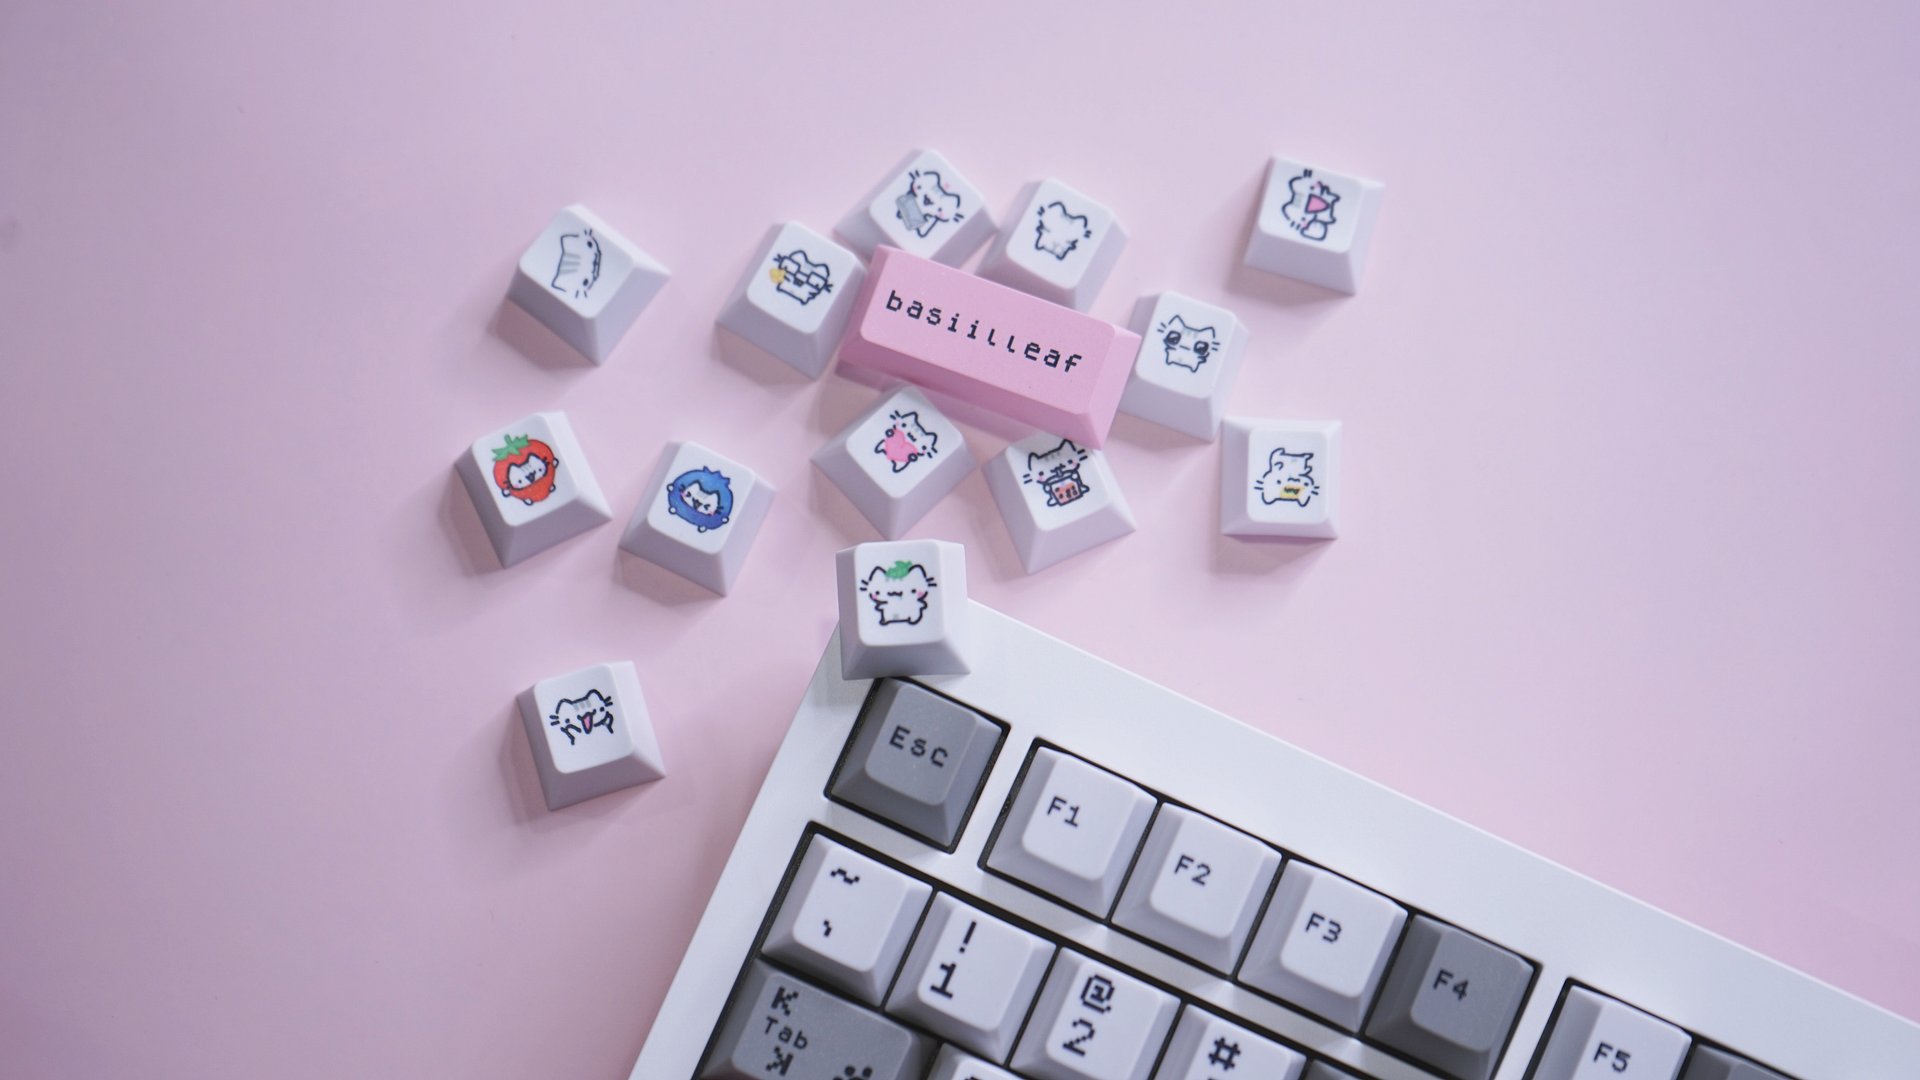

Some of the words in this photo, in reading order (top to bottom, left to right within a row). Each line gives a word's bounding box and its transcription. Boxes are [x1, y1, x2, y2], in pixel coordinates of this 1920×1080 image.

[885, 289, 1082, 373] basiilleaf
[888, 725, 949, 768] Esc
[1046, 796, 1080, 828] F1
[1174, 855, 1212, 886] F2
[1305, 912, 1343, 944] F3
[930, 963, 957, 999] 1
[1433, 969, 1469, 1001] F4
[764, 1016, 808, 1049] Tab
[1062, 1019, 1095, 1056] 2
[1593, 1041, 1632, 1073] F5
